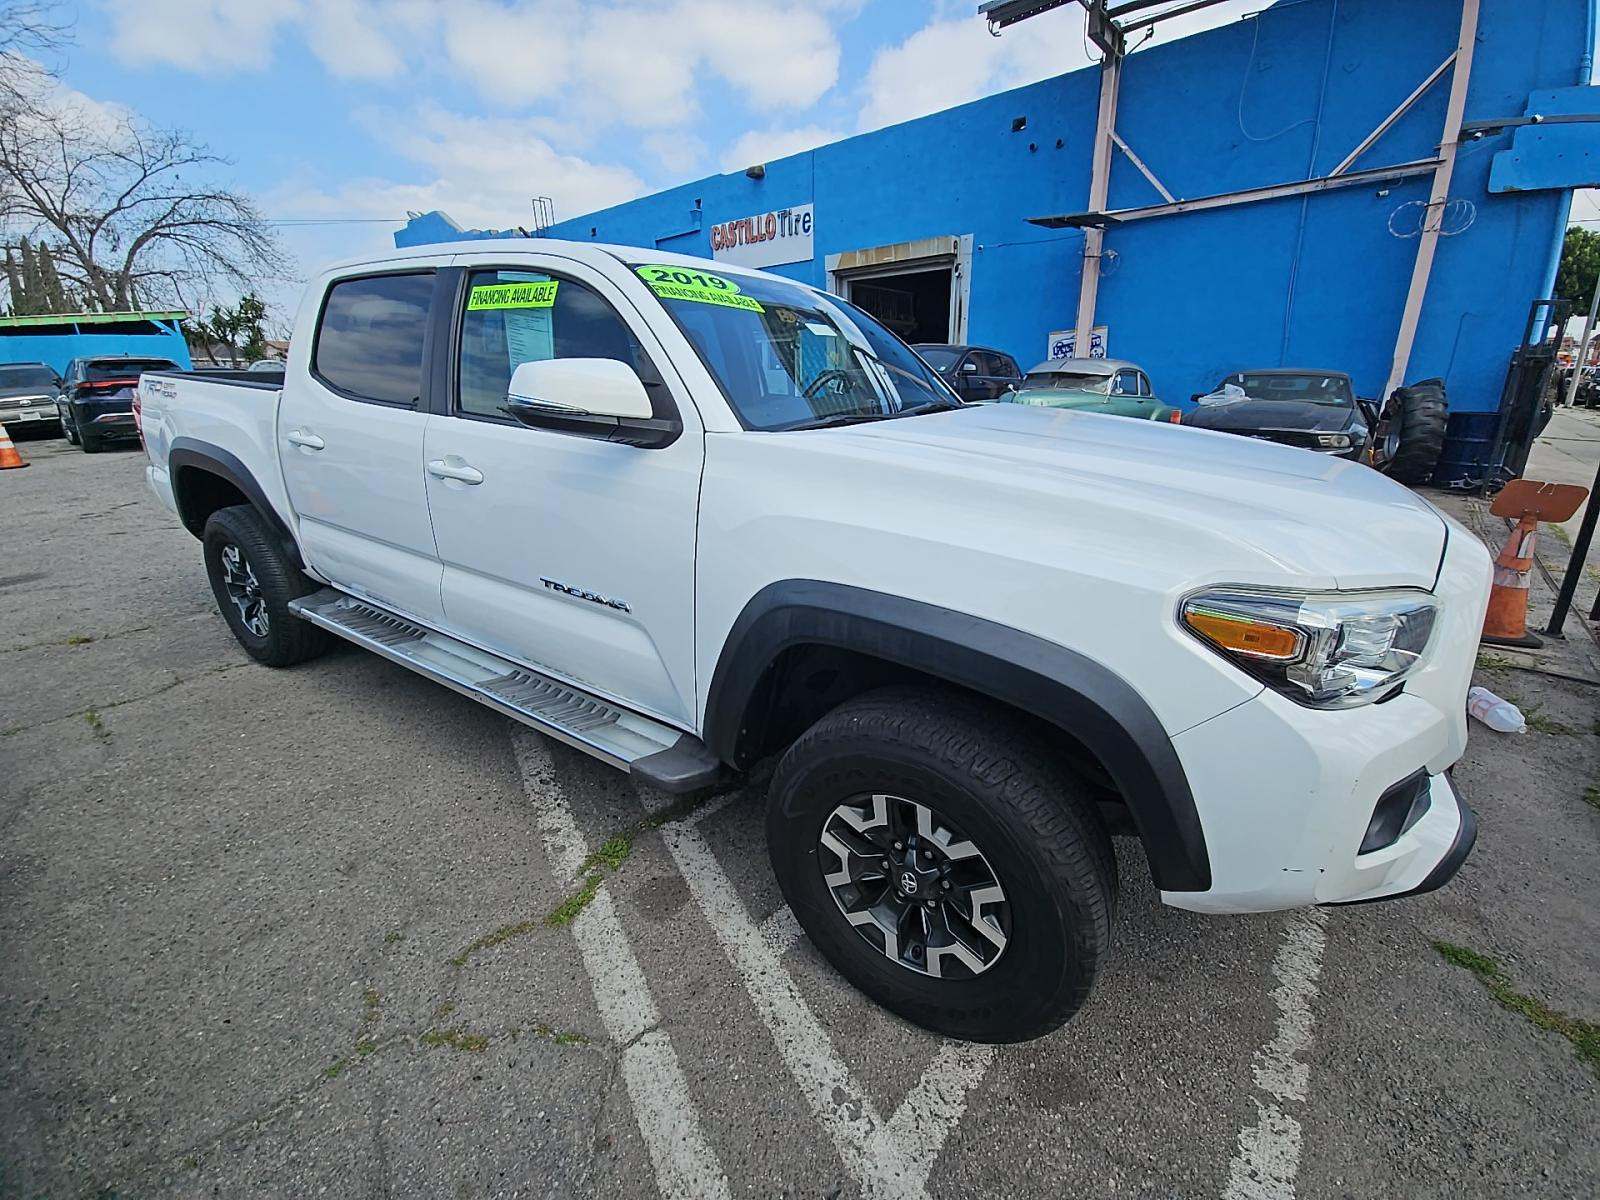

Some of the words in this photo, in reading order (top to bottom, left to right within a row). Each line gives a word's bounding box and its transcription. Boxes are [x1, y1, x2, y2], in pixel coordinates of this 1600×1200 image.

[711, 213, 777, 251] CASTILLO
[777, 209, 812, 238] Tire
[651, 269, 728, 290] 2019
[470, 288, 511, 306] FINANCING
[510, 285, 555, 304] AVAILABLE
[652, 284, 711, 301] FINANCING
[539, 577, 631, 614] TACOMA
